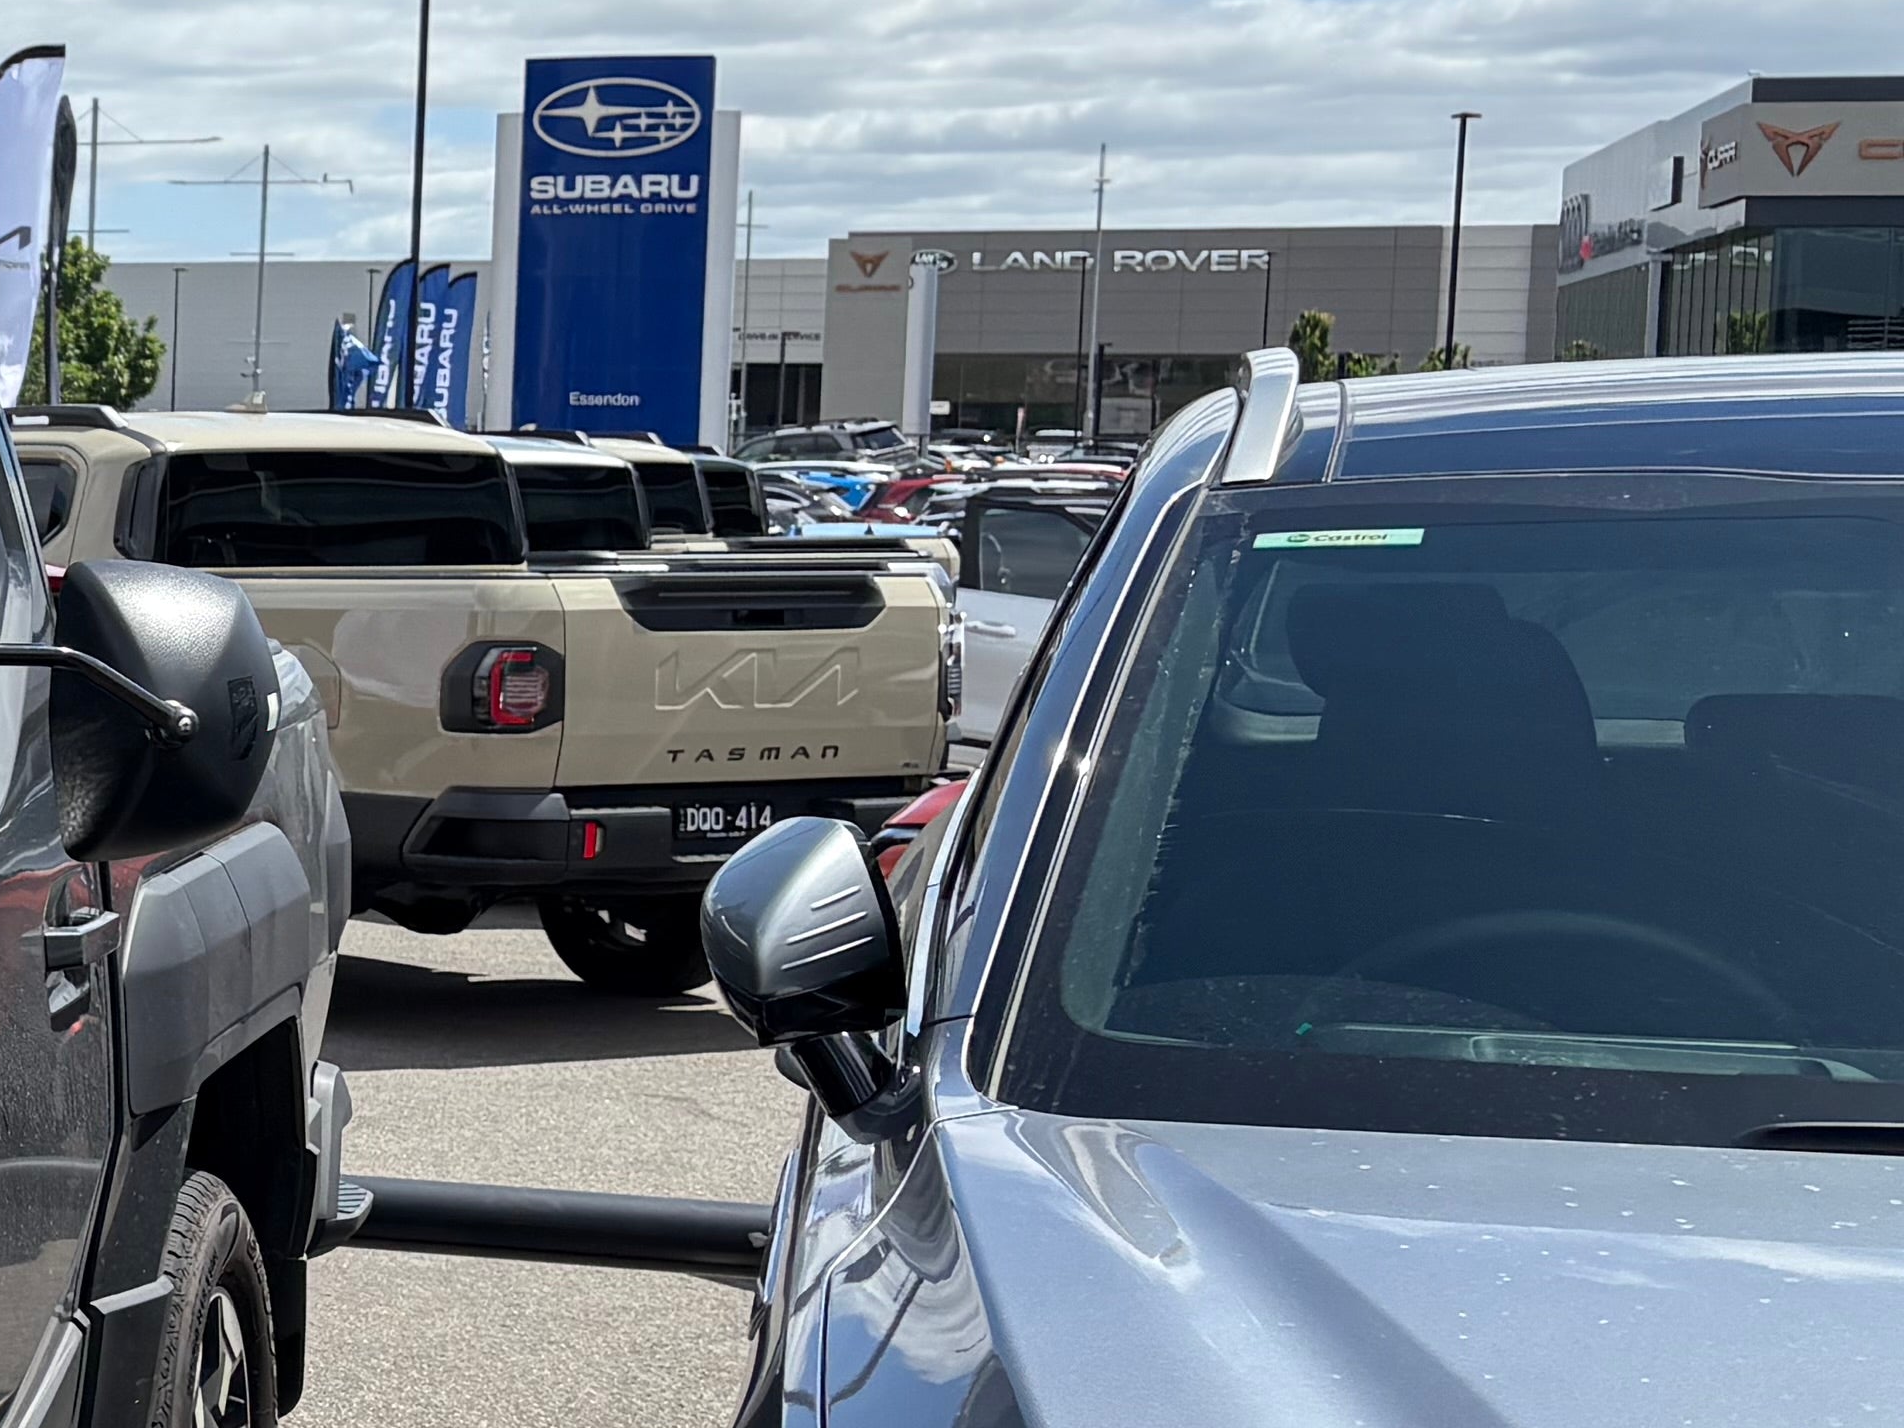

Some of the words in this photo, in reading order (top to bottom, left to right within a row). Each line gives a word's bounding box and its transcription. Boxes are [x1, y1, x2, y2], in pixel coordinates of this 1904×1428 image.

[529, 174, 700, 200] SUBARU
[530, 203, 635, 215] ALL-WHEEL
[639, 202, 698, 215] DRIVE
[972, 251, 1094, 271] LAND
[1113, 249, 1271, 272] ROVER
[568, 391, 641, 407] Essendon
[1313, 533, 1389, 544] Castrol
[654, 645, 861, 710] KIA
[666, 744, 840, 764] TASMAN
